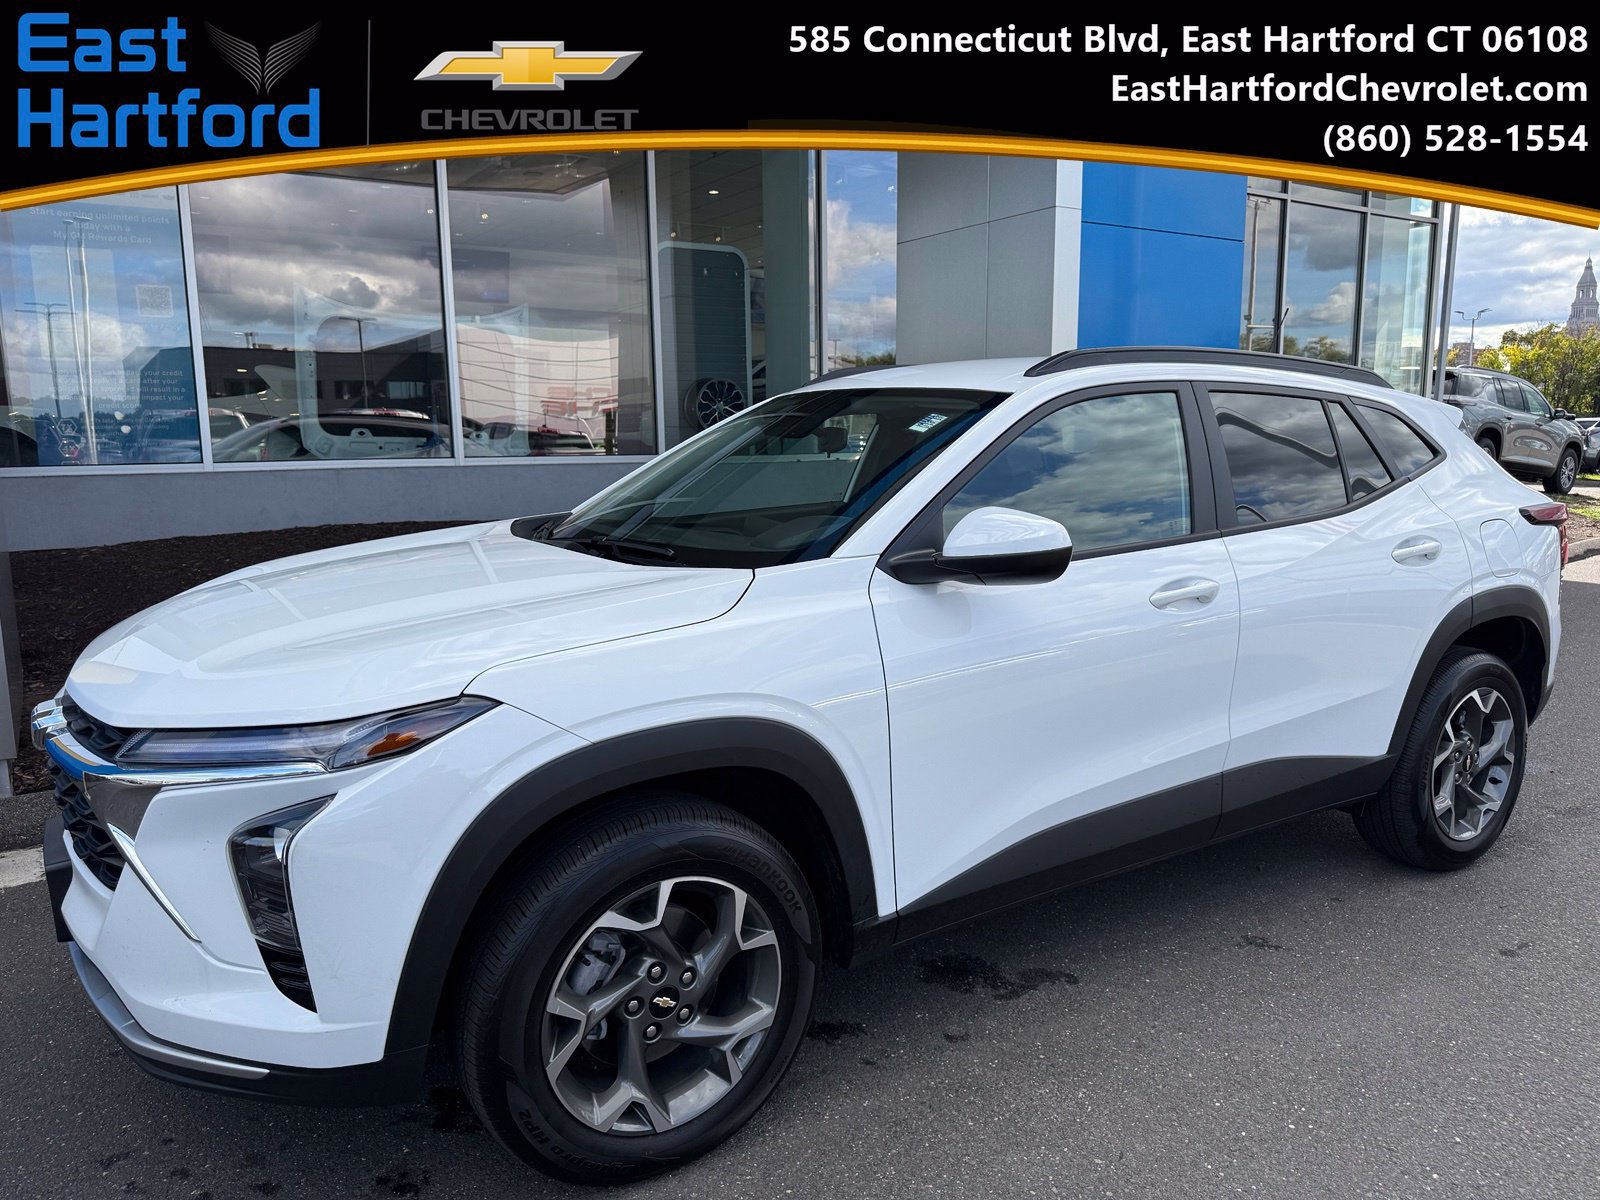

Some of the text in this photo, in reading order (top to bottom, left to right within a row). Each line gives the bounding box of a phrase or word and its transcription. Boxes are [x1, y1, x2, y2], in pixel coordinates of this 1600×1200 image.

[30, 207, 55, 216] Start
[141, 216, 170, 225] points
[103, 223, 123, 232] with
[53, 231, 67, 241] My
[88, 233, 128, 242] Rewards
[131, 235, 152, 244] Card
